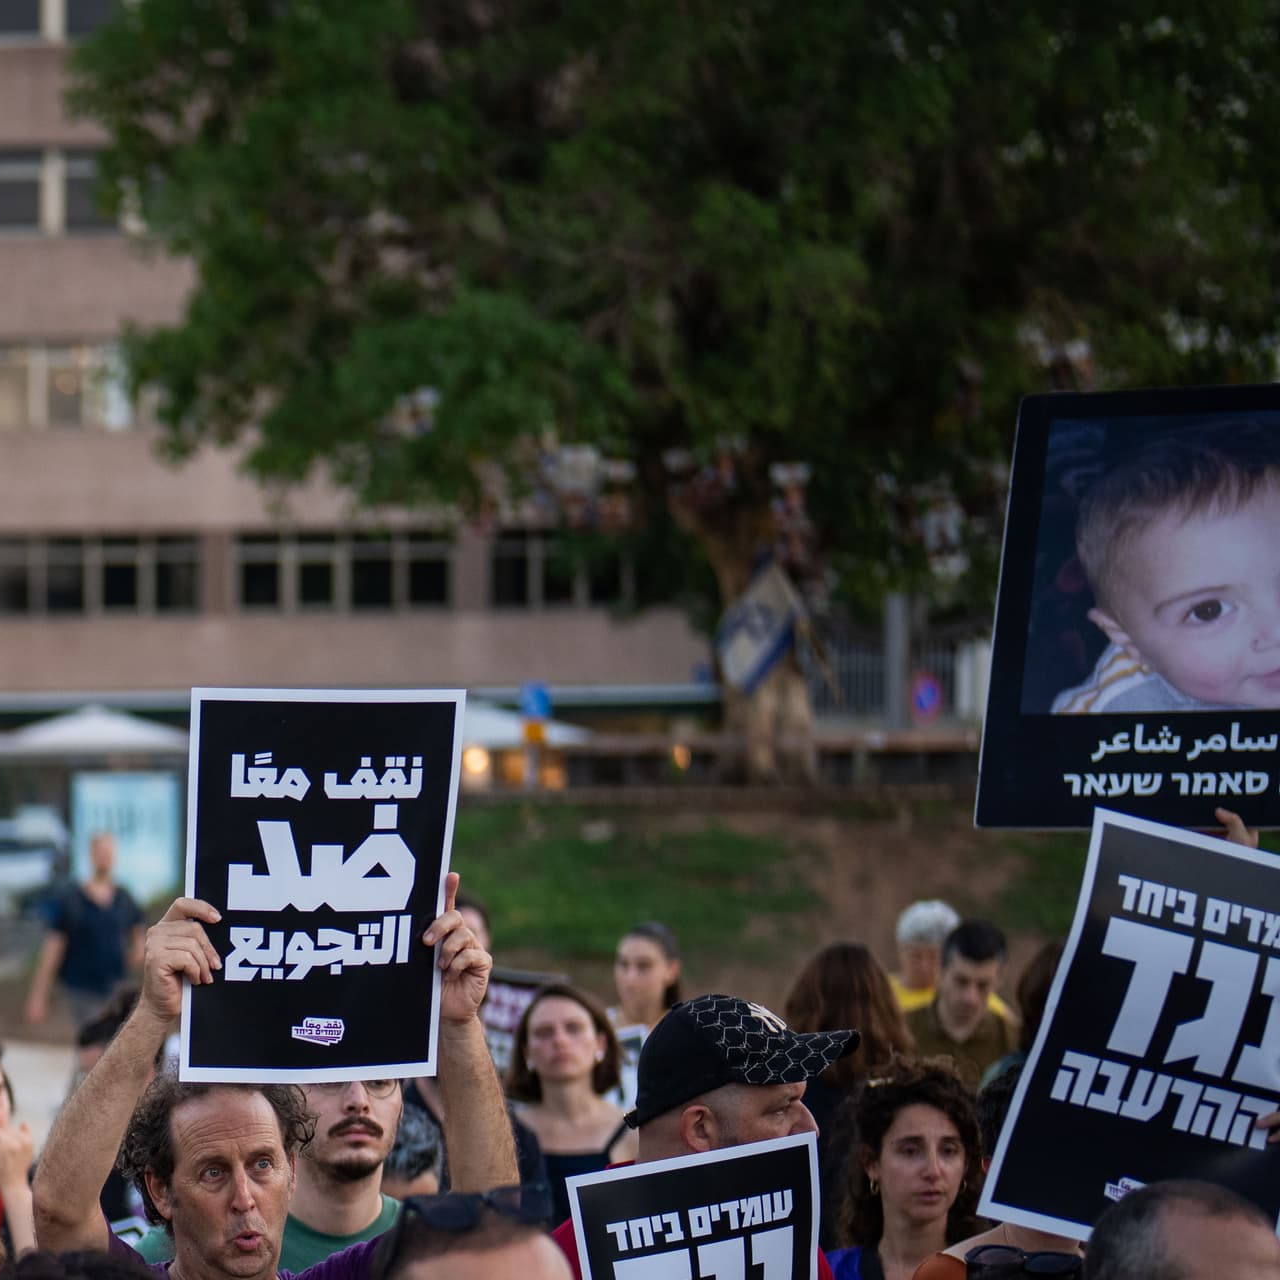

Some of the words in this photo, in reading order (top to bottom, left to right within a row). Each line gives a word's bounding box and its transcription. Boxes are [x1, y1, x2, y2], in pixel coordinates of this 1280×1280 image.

[1091, 723, 1182, 762] شاعر
[323, 755, 423, 800] نقف
[1063, 772, 1163, 797] שעאר
[1171, 770, 1269, 796] סאמר
[227, 803, 416, 913] ضد
[1118, 873, 1198, 928] ביחד
[1201, 896, 1280, 950] מדים
[224, 914, 413, 982] التجويع
[1049, 1049, 1280, 1151] ההרעבה
[605, 1211, 684, 1251] ביחד
[687, 1189, 793, 1238] עומדים
